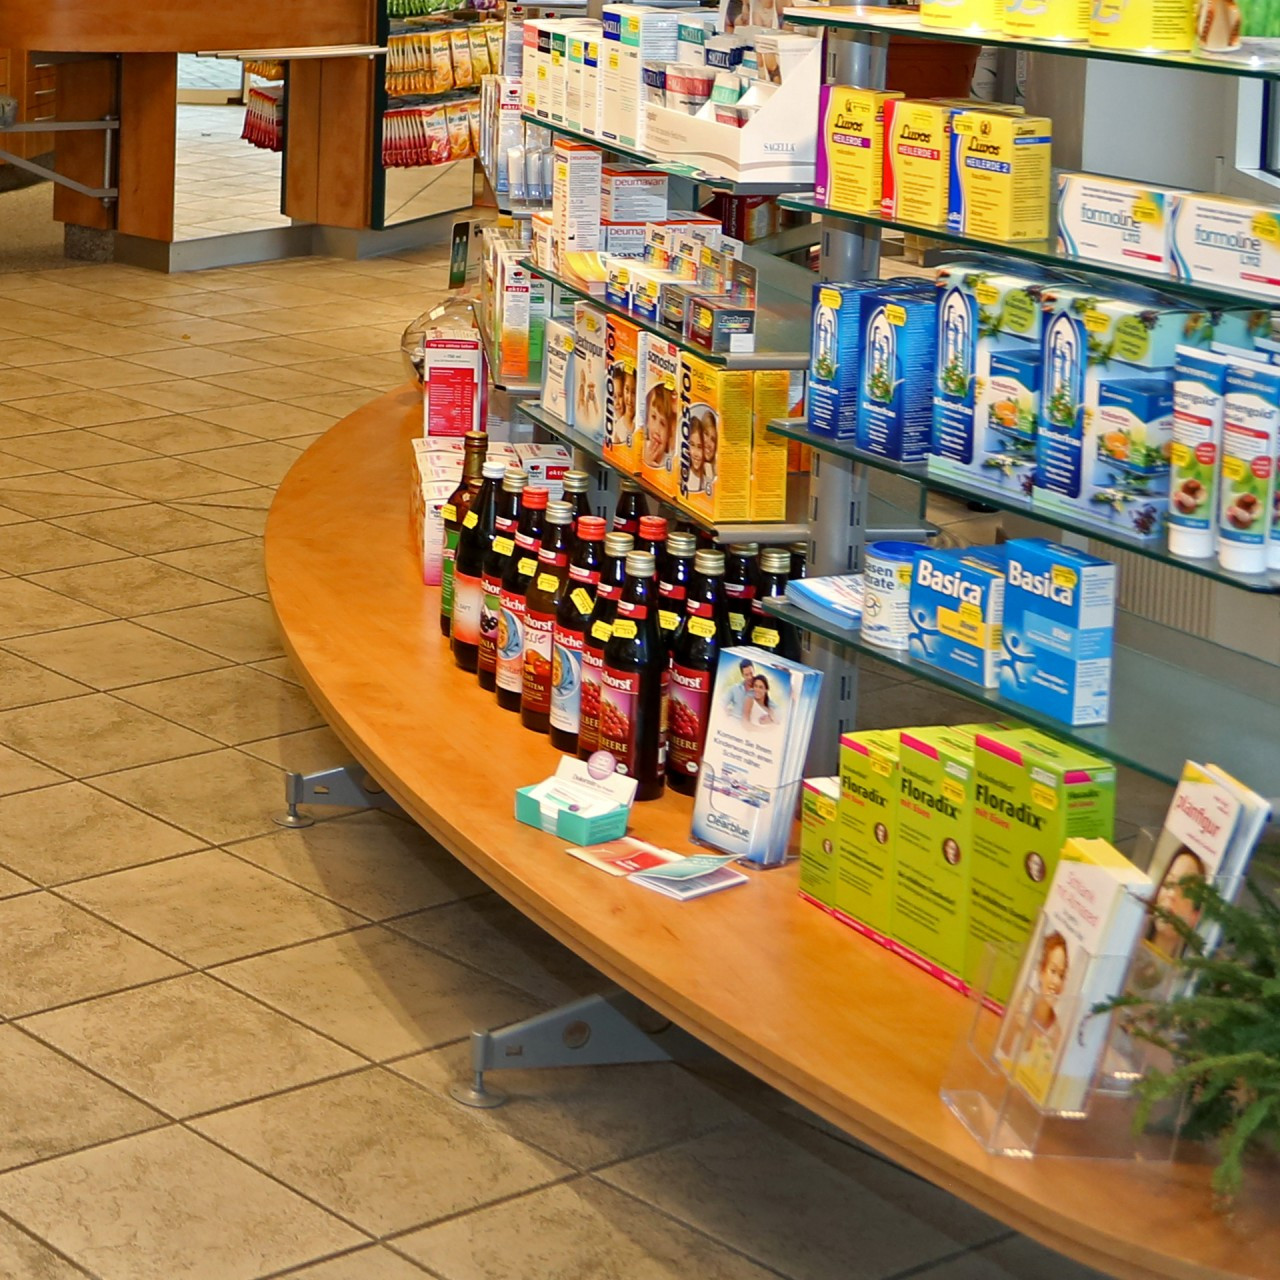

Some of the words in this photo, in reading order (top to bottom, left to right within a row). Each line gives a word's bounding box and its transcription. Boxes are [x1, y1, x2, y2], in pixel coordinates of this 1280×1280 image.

[834, 113, 864, 133] Luvos
[832, 133, 863, 147] HEILERDE
[900, 124, 932, 144] Luvos
[763, 142, 796, 153] SAGELLA
[898, 144, 933, 159] HEILERDE
[933, 150, 939, 159] 1
[968, 136, 1001, 155] Luvos
[965, 157, 1002, 171] HEILERDE
[1002, 163, 1009, 173] 2
[614, 177, 665, 188] Deumavan
[1081, 203, 1141, 229] formoline
[1196, 225, 1262, 252] formoline
[647, 350, 677, 373] sanostol
[680, 360, 692, 501] sanostol
[866, 563, 893, 578] asen
[917, 559, 983, 606] Basica
[1008, 559, 1073, 607] Basica
[602, 736, 628, 753] BEERE
[842, 775, 887, 808] Floradix
[901, 778, 958, 819] Floradix
[976, 783, 1043, 831] Floradix
[706, 813, 750, 838] Clearblue
